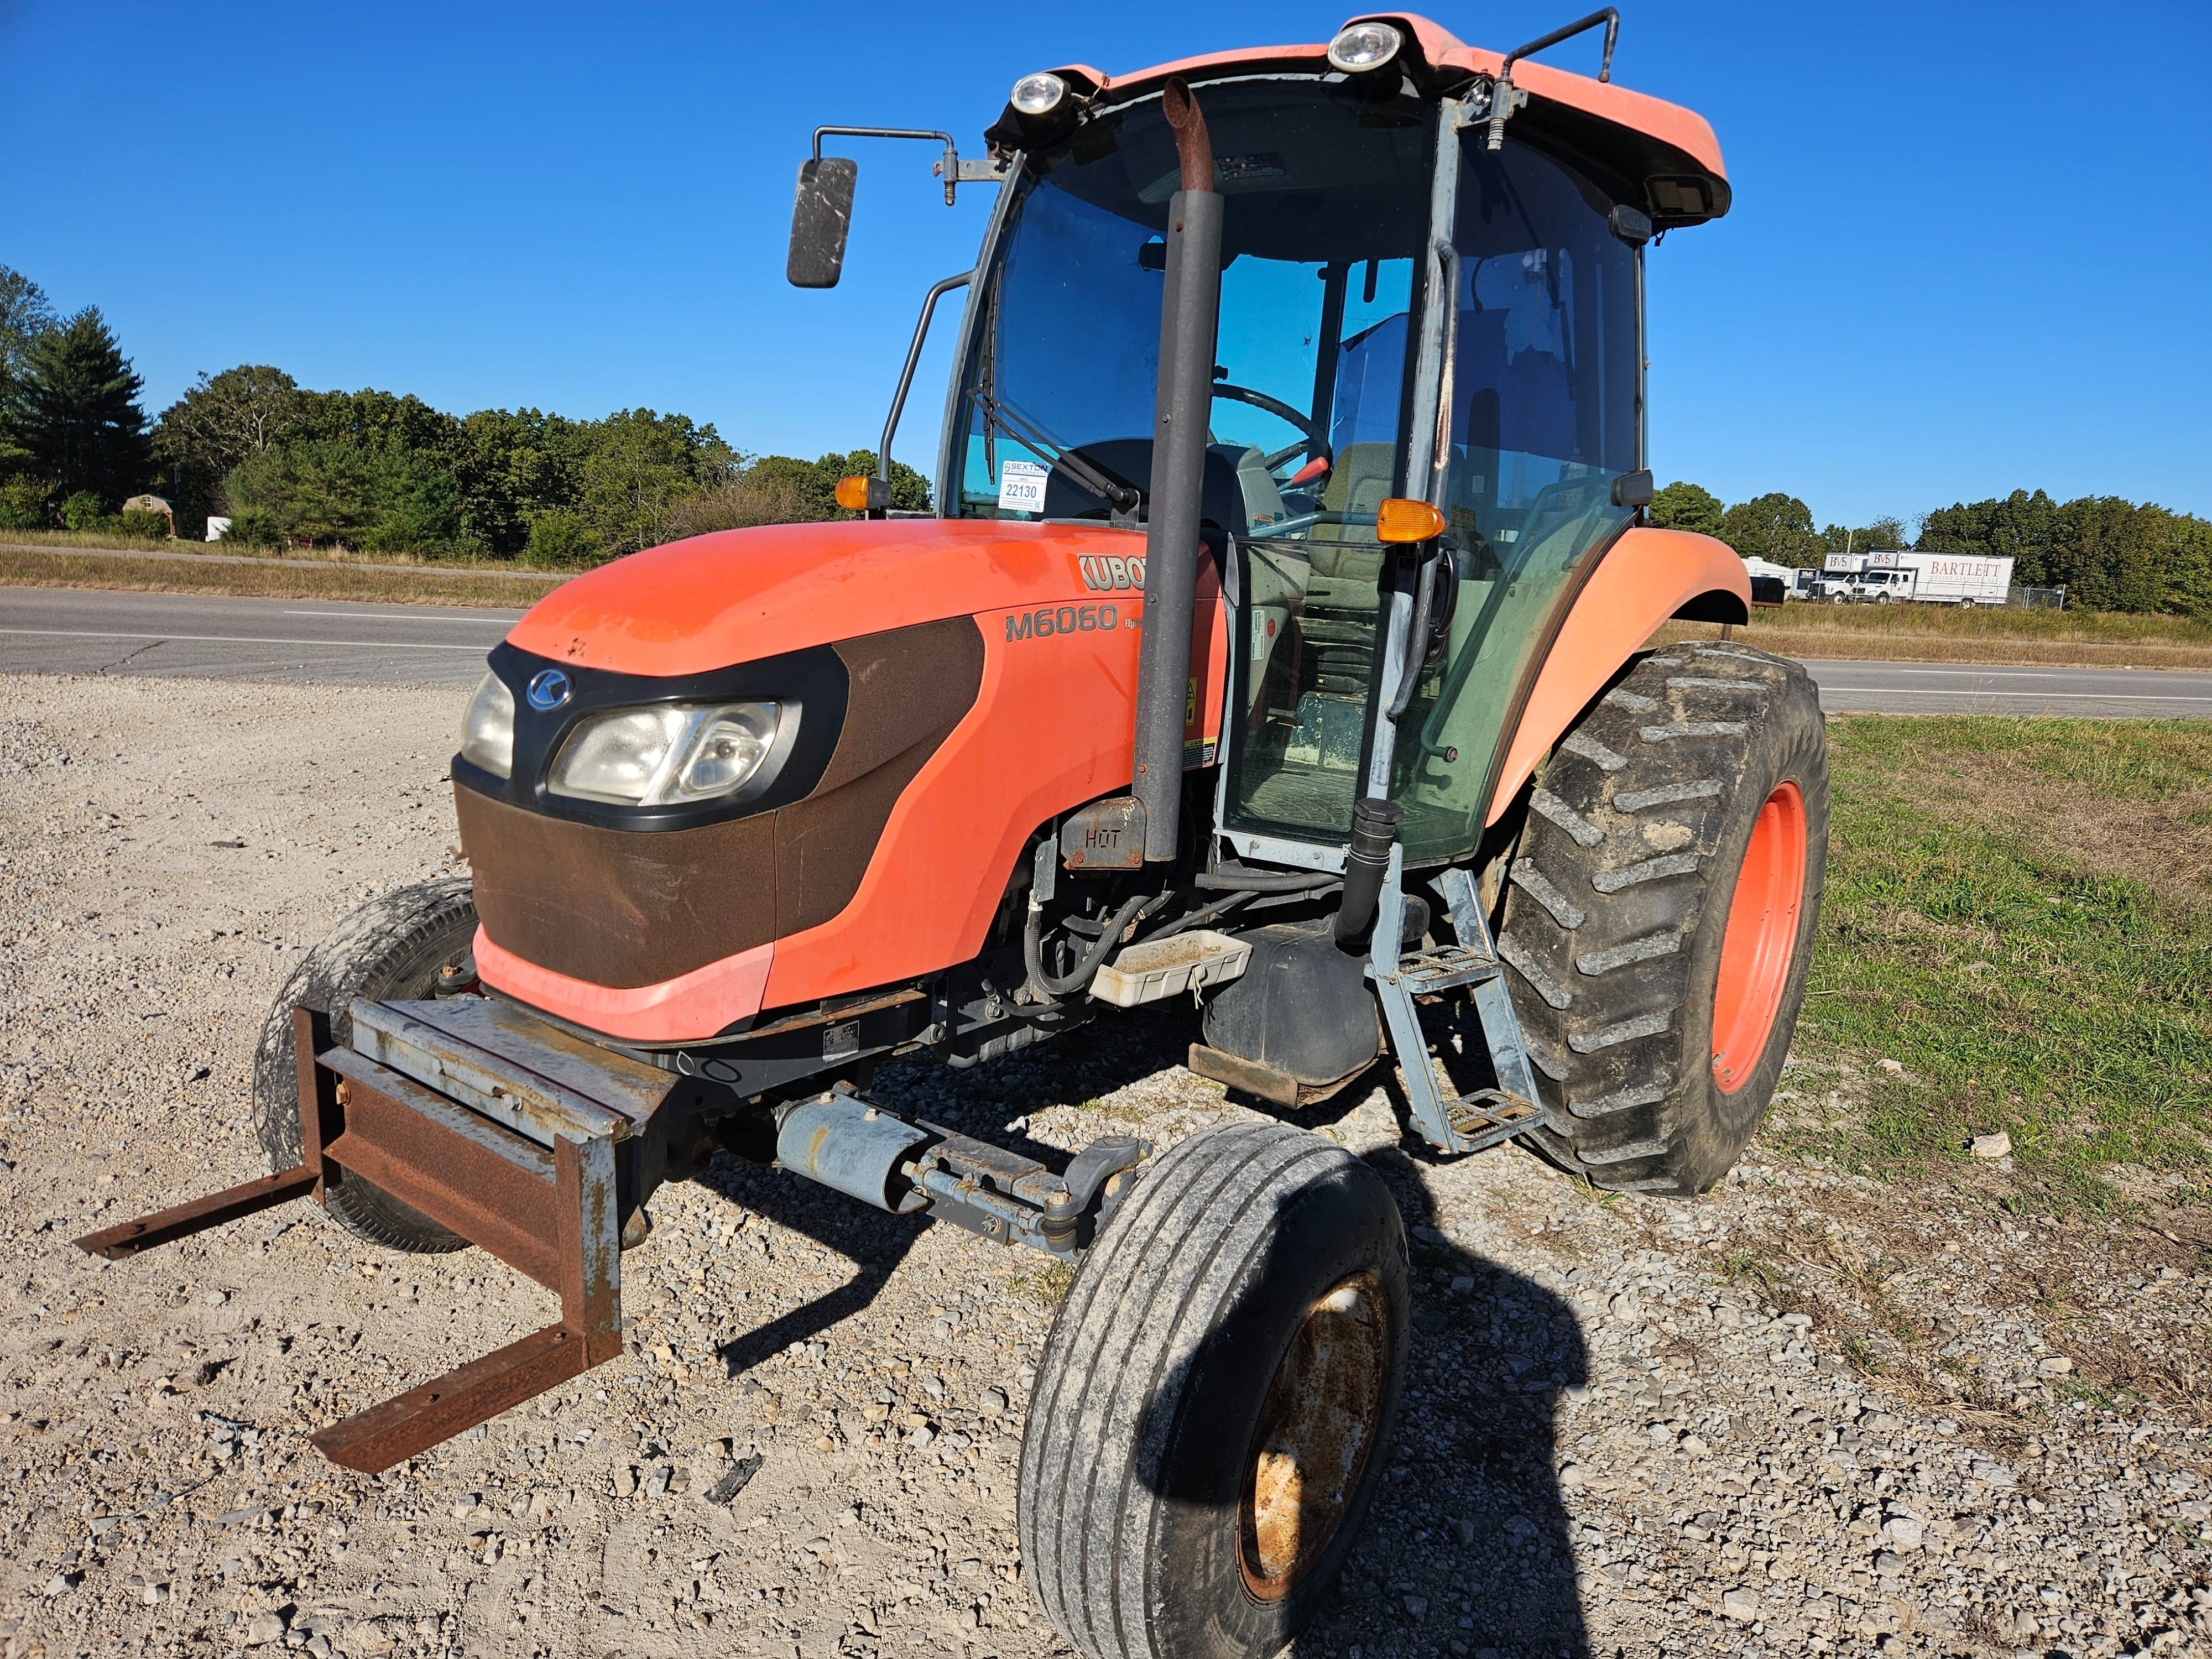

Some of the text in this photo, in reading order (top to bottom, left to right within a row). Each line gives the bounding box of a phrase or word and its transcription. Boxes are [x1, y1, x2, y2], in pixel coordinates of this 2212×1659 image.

[1011, 463, 1048, 472] SEXTON
[1006, 484, 1037, 498] 22130
[1078, 556, 1147, 591] KUBO
[1931, 562, 2001, 577] BARTLETT
[1006, 604, 1117, 643] M6060
[1086, 830, 1121, 848] HOT
